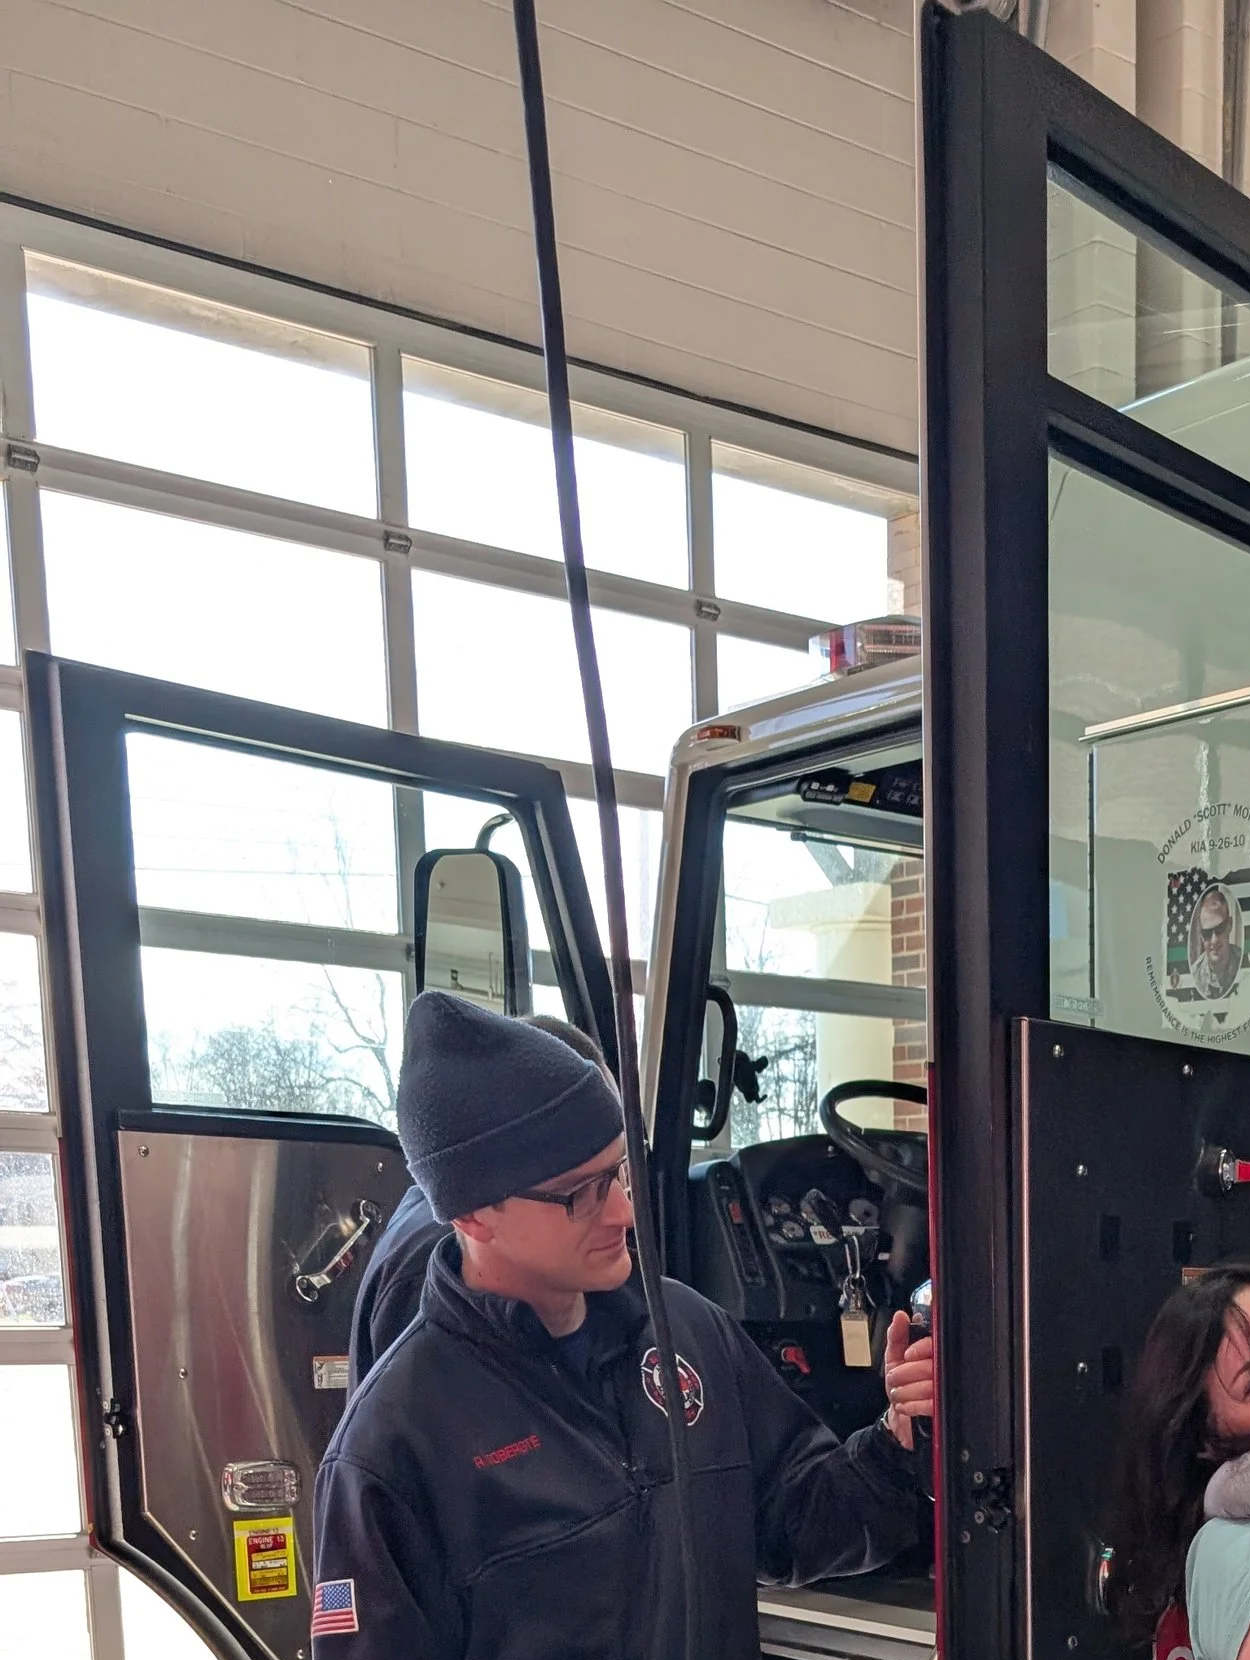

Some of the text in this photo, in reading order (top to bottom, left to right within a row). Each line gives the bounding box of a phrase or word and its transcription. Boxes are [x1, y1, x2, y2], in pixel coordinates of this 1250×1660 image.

[1157, 819, 1192, 864] DONALD
[1193, 803, 1231, 822] "SCOTT"
[1190, 834, 1246, 854] KIA 9-26-10
[1145, 956, 1183, 1032] REMEMBRANCE
[1181, 1025, 1189, 1037] IS
[1190, 1031, 1205, 1044] THE
[1207, 1027, 1241, 1044] HIGHEST
[248, 1536, 273, 1545] ENGINE
